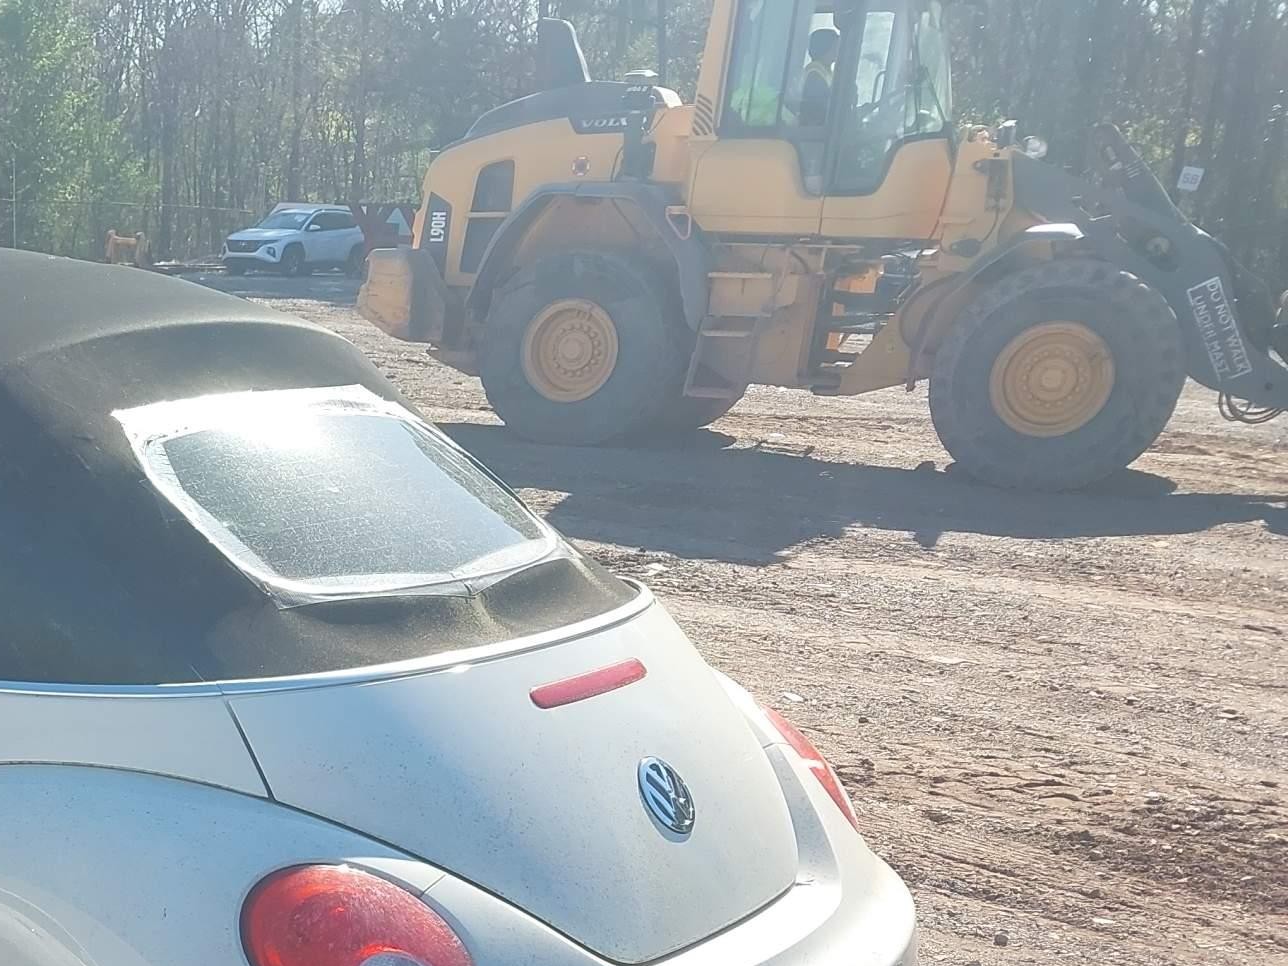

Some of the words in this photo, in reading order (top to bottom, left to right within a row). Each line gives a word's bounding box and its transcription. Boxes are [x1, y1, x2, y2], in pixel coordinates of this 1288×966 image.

[429, 211, 447, 242] L90H
[1206, 281, 1222, 302] DO
[1215, 304, 1233, 331] NOT
[1225, 334, 1248, 372] WALK
